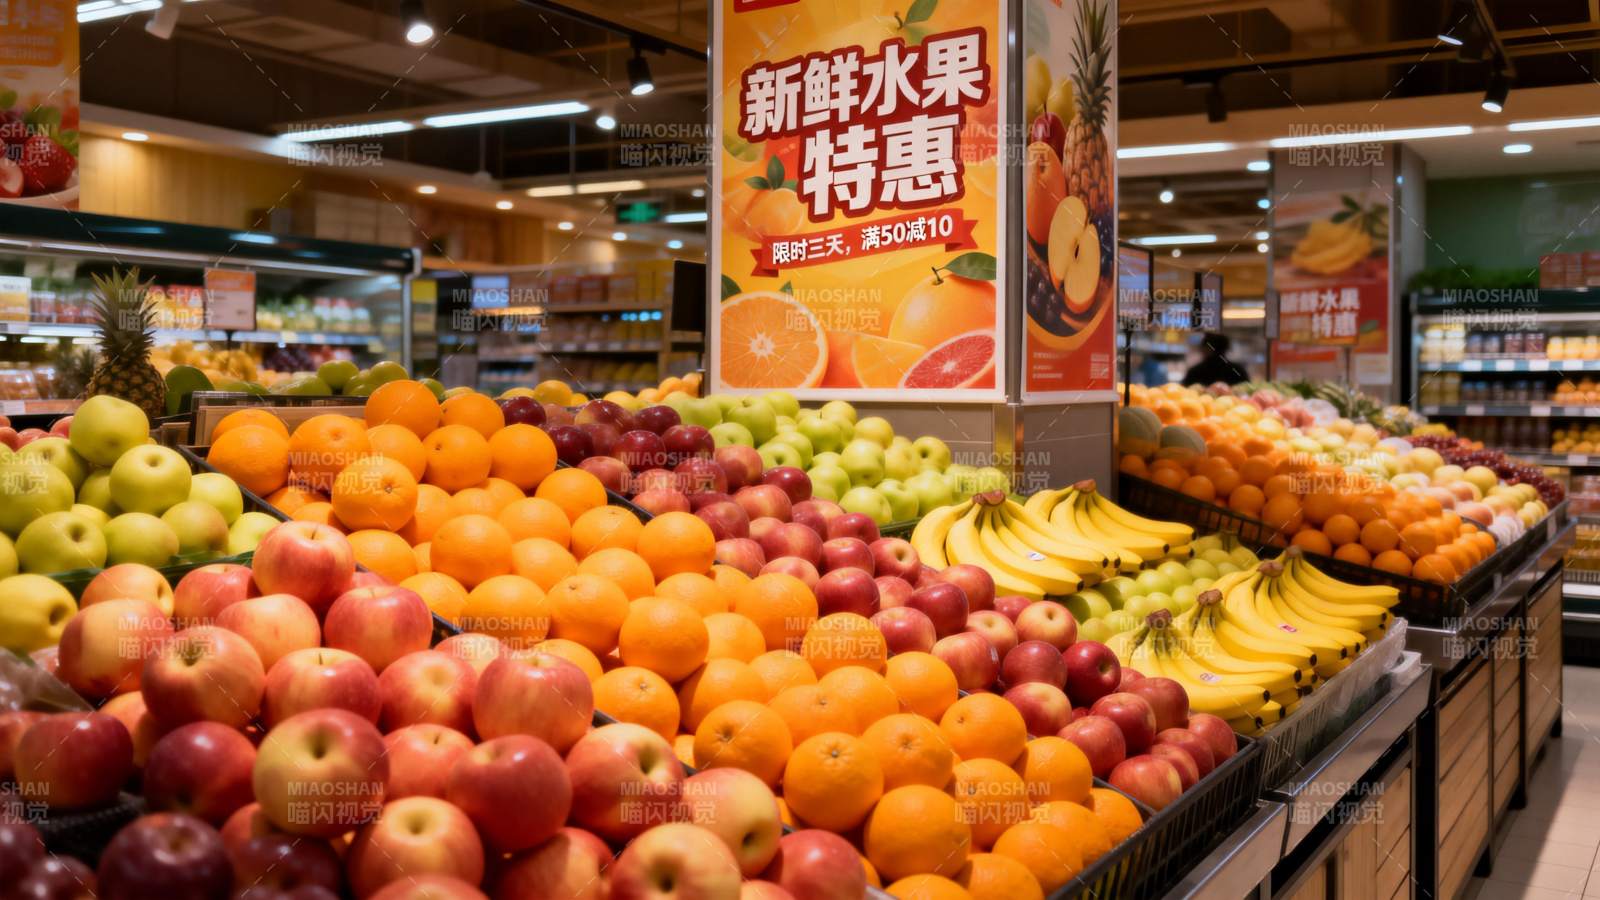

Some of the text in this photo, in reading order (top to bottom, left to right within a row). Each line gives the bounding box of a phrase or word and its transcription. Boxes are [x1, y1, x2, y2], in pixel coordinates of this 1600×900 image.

[744, 34, 984, 136] 新鲜水果
[803, 114, 959, 215] 特惠
[772, 215, 953, 264] 限时三天，满50减10
